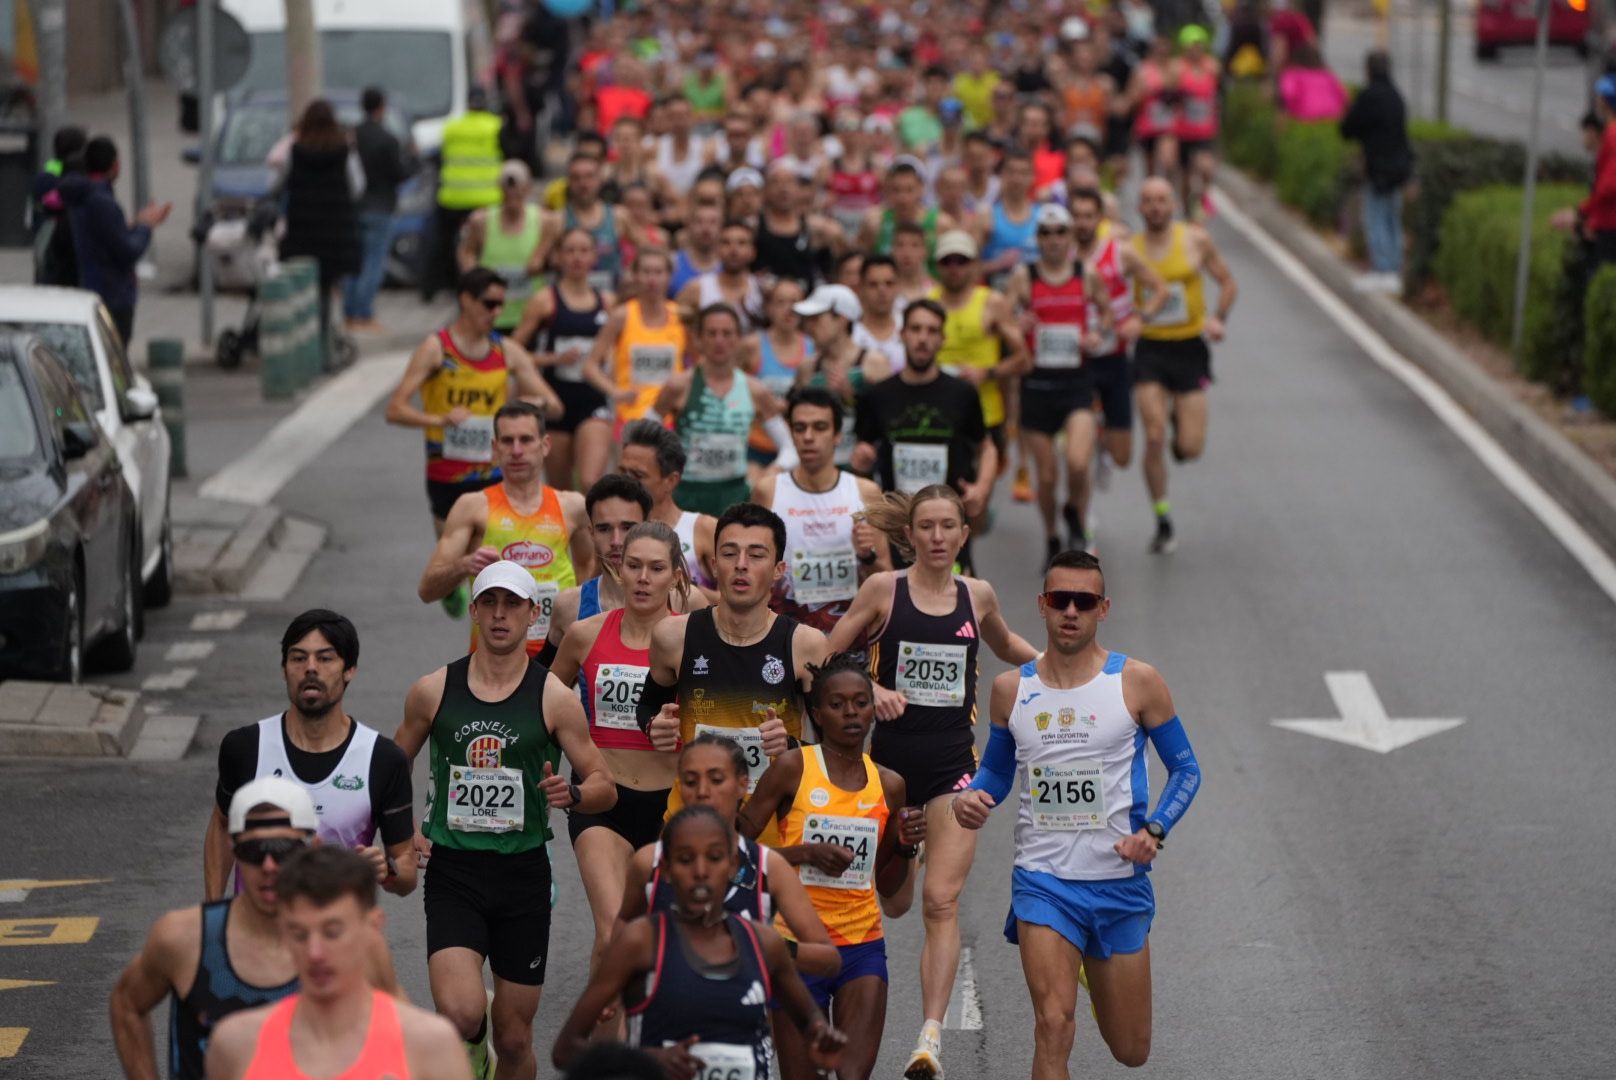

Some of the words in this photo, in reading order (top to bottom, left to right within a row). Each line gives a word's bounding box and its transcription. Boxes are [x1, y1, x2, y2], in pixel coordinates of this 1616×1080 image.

[447, 388, 497, 407] UPV
[508, 546, 551, 561] Serrano
[800, 559, 849, 581] 2115
[904, 659, 958, 682] 2053
[602, 679, 645, 704] 205
[909, 681, 951, 691] GRØVDAL
[611, 703, 637, 714] KOST
[456, 784, 515, 808] 2022
[1037, 779, 1096, 804] 2156
[472, 808, 498, 817] LORE
[849, 862, 867, 871] GAT
